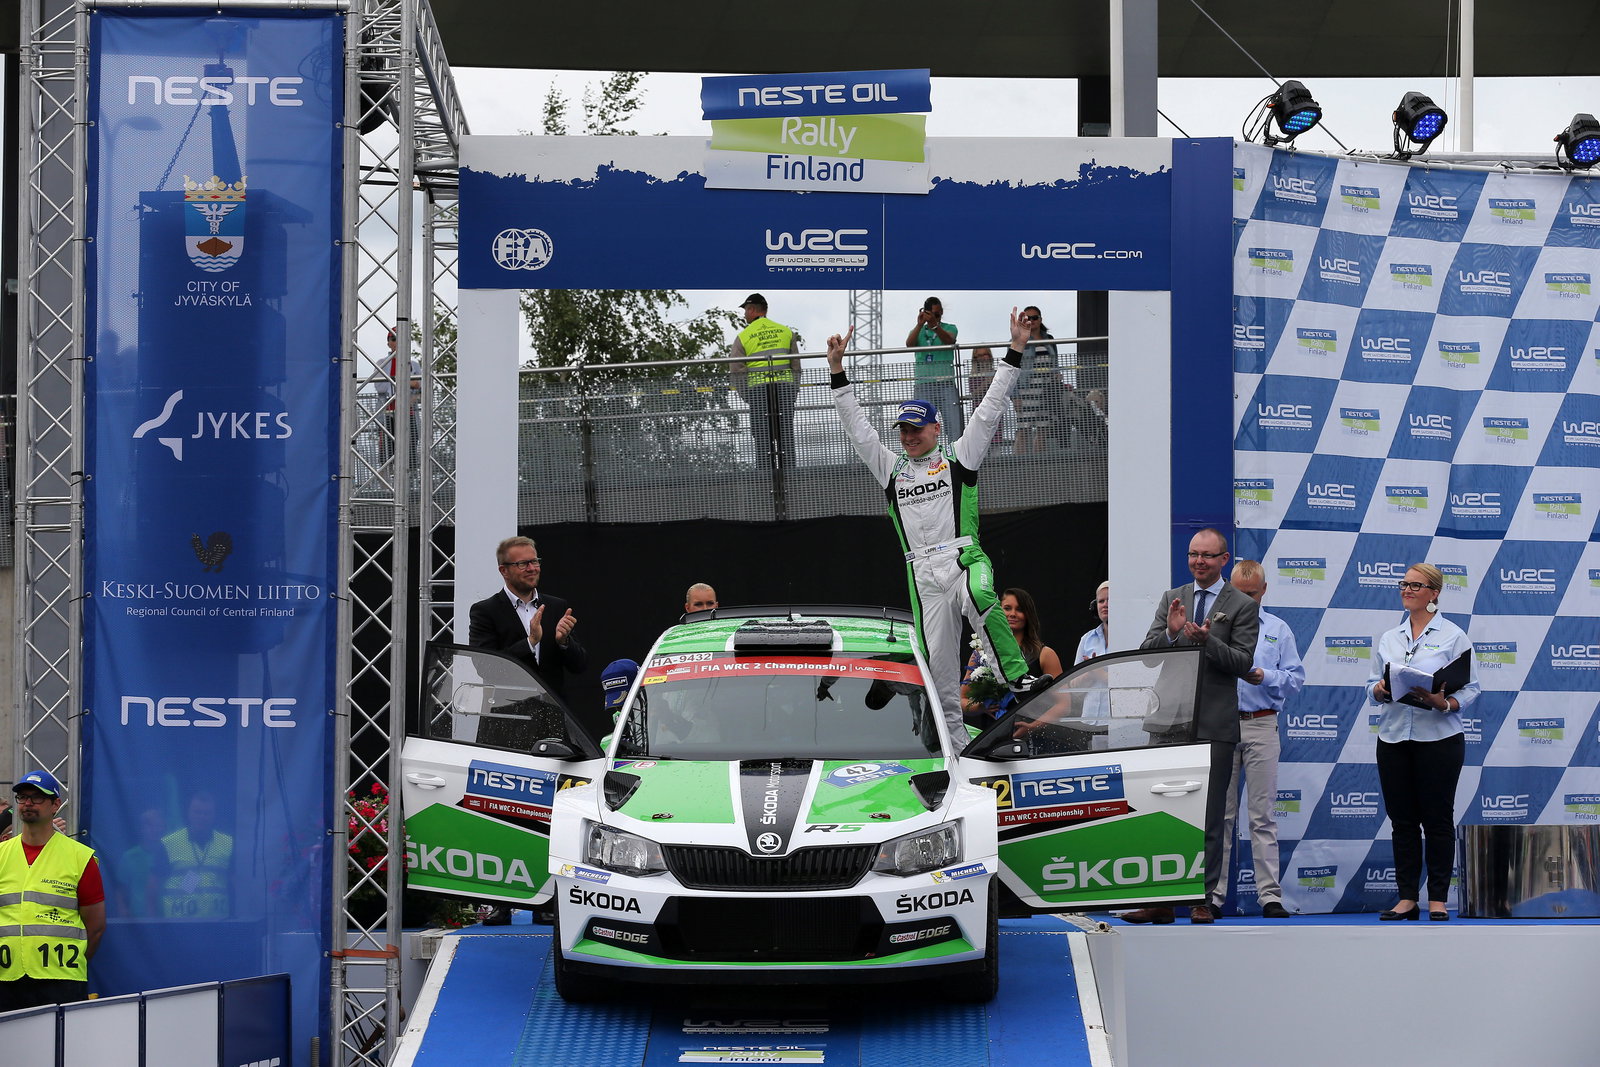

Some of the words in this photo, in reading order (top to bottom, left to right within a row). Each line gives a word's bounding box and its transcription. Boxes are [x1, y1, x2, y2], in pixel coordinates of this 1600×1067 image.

[127, 75, 304, 107] NESTE
[738, 84, 846, 107] NESTE
[852, 83, 898, 101] OIL
[781, 116, 857, 154] Rally
[767, 154, 864, 182] Finland
[1273, 175, 1317, 194] WRC
[1352, 204, 1369, 214] Finland
[1408, 193, 1458, 210] WRC
[1569, 202, 1600, 217] WR
[1502, 216, 1524, 225] Finland
[766, 229, 868, 251] WRC
[1022, 243, 1143, 259] WRC.com
[1262, 267, 1283, 277] Finland
[1319, 256, 1361, 275] WRC
[1459, 270, 1510, 286] WRC
[187, 281, 213, 292] CITY
[221, 281, 240, 292] OF
[1403, 282, 1423, 291] Finland
[174, 294, 252, 307] JYVÄSKYLÄ
[1559, 290, 1581, 299] Finland
[1361, 336, 1411, 352] WRC
[1308, 347, 1328, 357] Finland
[1510, 346, 1566, 360] WRC
[1447, 360, 1466, 369] Finland
[1258, 403, 1312, 419] WRC
[192, 412, 292, 439] JYKES
[1409, 413, 1452, 430] WRC
[1351, 427, 1369, 436] Finland
[1497, 436, 1516, 445] Finland
[898, 479, 949, 499] ŠKODA
[1307, 482, 1356, 498] WRC
[1238, 498, 1260, 507] Finland
[1398, 505, 1418, 514] Finland
[1547, 511, 1569, 520] Finland
[1357, 561, 1406, 576] WRC
[1500, 568, 1556, 583] WRC
[1291, 576, 1314, 586] Finland
[258, 584, 321, 600] LIITTO
[126, 606, 168, 617] Regional
[170, 607, 206, 616] Council
[208, 606, 220, 616] of
[222, 607, 257, 617] Central
[260, 607, 295, 617] Finland
[651, 653, 712, 667] HA-9432
[764, 662, 847, 671] Championship
[1337, 655, 1359, 664] Finland
[1479, 660, 1502, 670] Finland
[121, 696, 297, 728] NESTE
[1287, 713, 1338, 729] WRC
[1530, 737, 1553, 746] Finland
[766, 762, 782, 789] Motorsport
[846, 766, 873, 775] 42
[847, 769, 898, 784] NESTE
[473, 769, 543, 795] NESTE
[1020, 774, 1110, 798] NESTE
[1106, 766, 1121, 774] '15
[1330, 791, 1380, 806] WRC
[1481, 793, 1530, 809] WRC
[489, 803, 498, 811] FIA
[499, 804, 511, 812] WRC
[759, 789, 779, 825] ŠKODA
[1005, 814, 1016, 822] FIA
[1017, 812, 1032, 821] WRC
[1033, 811, 1038, 819] 2
[1039, 809, 1084, 819] Championship
[1574, 812, 1598, 821] Finland
[804, 825, 866, 833] R5
[577, 870, 610, 881] MICHELIN
[951, 865, 985, 877] MICHELIN
[1307, 885, 1326, 893] Finland
[569, 885, 641, 913] ŠKODA
[896, 889, 974, 914] ŠKODA
[615, 931, 649, 944] EDGE
[896, 933, 916, 942] Castrol
[917, 925, 951, 940] EDGE
[37, 943, 79, 969] 112
